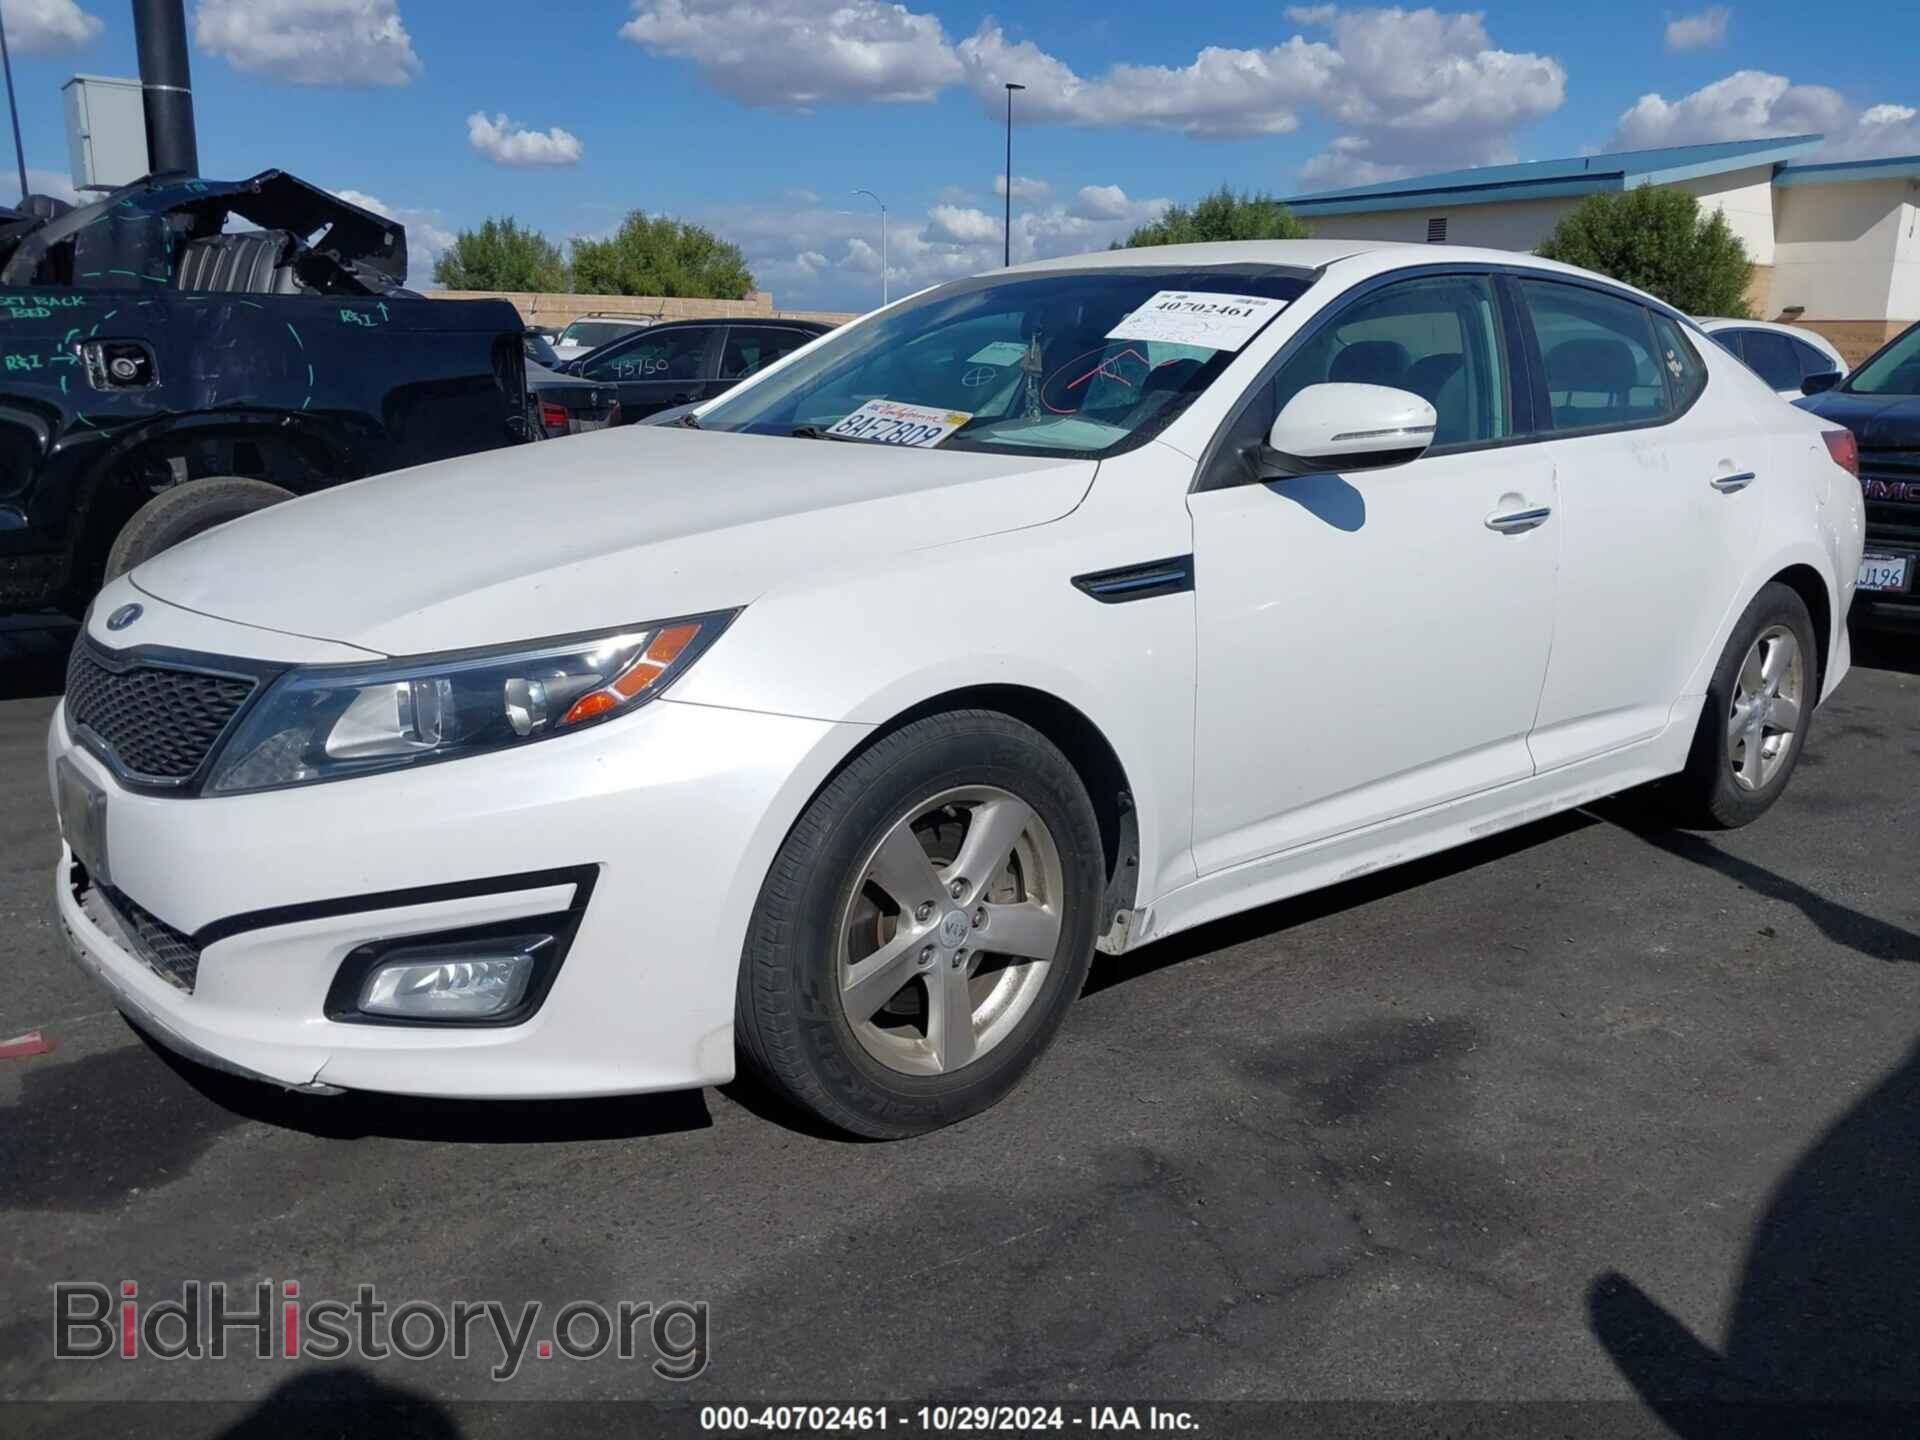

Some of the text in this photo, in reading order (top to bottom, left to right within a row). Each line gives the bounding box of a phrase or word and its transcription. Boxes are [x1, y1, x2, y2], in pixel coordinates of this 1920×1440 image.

[32, 295, 86, 307] BACK
[1155, 301, 1255, 318] 40702461
[836, 414, 943, 447] 8AFZ809
[1858, 567, 1902, 586] J196
